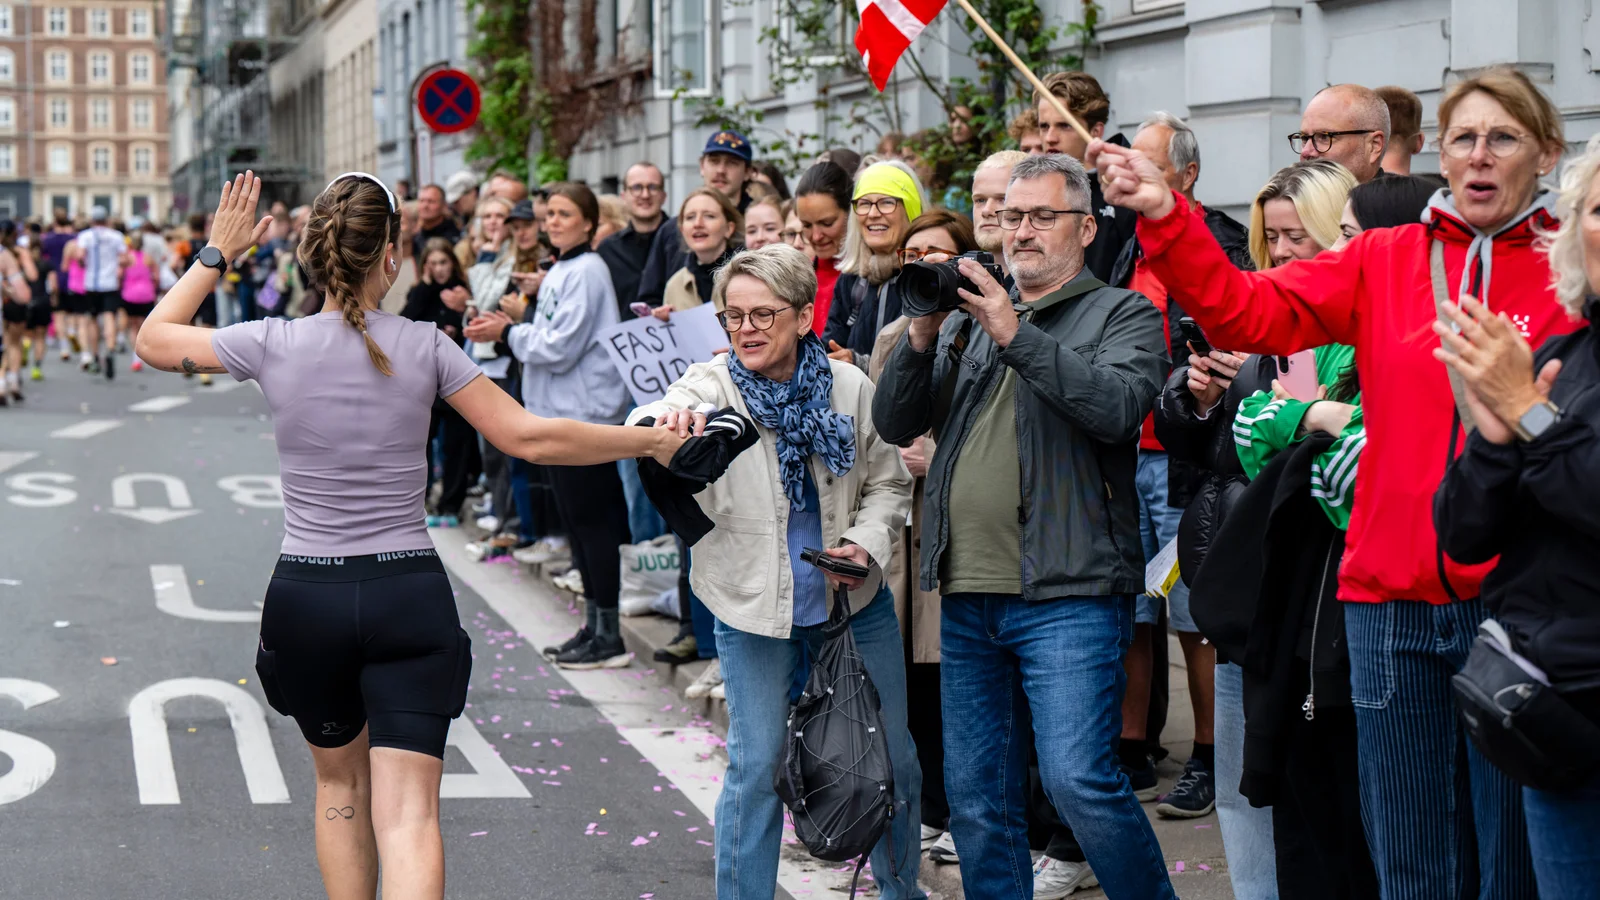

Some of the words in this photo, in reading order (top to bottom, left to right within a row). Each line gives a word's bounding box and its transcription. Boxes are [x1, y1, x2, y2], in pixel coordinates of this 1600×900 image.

[609, 323, 677, 363] FAST
[630, 358, 696, 396] GIR
[5, 472, 284, 508] BUS
